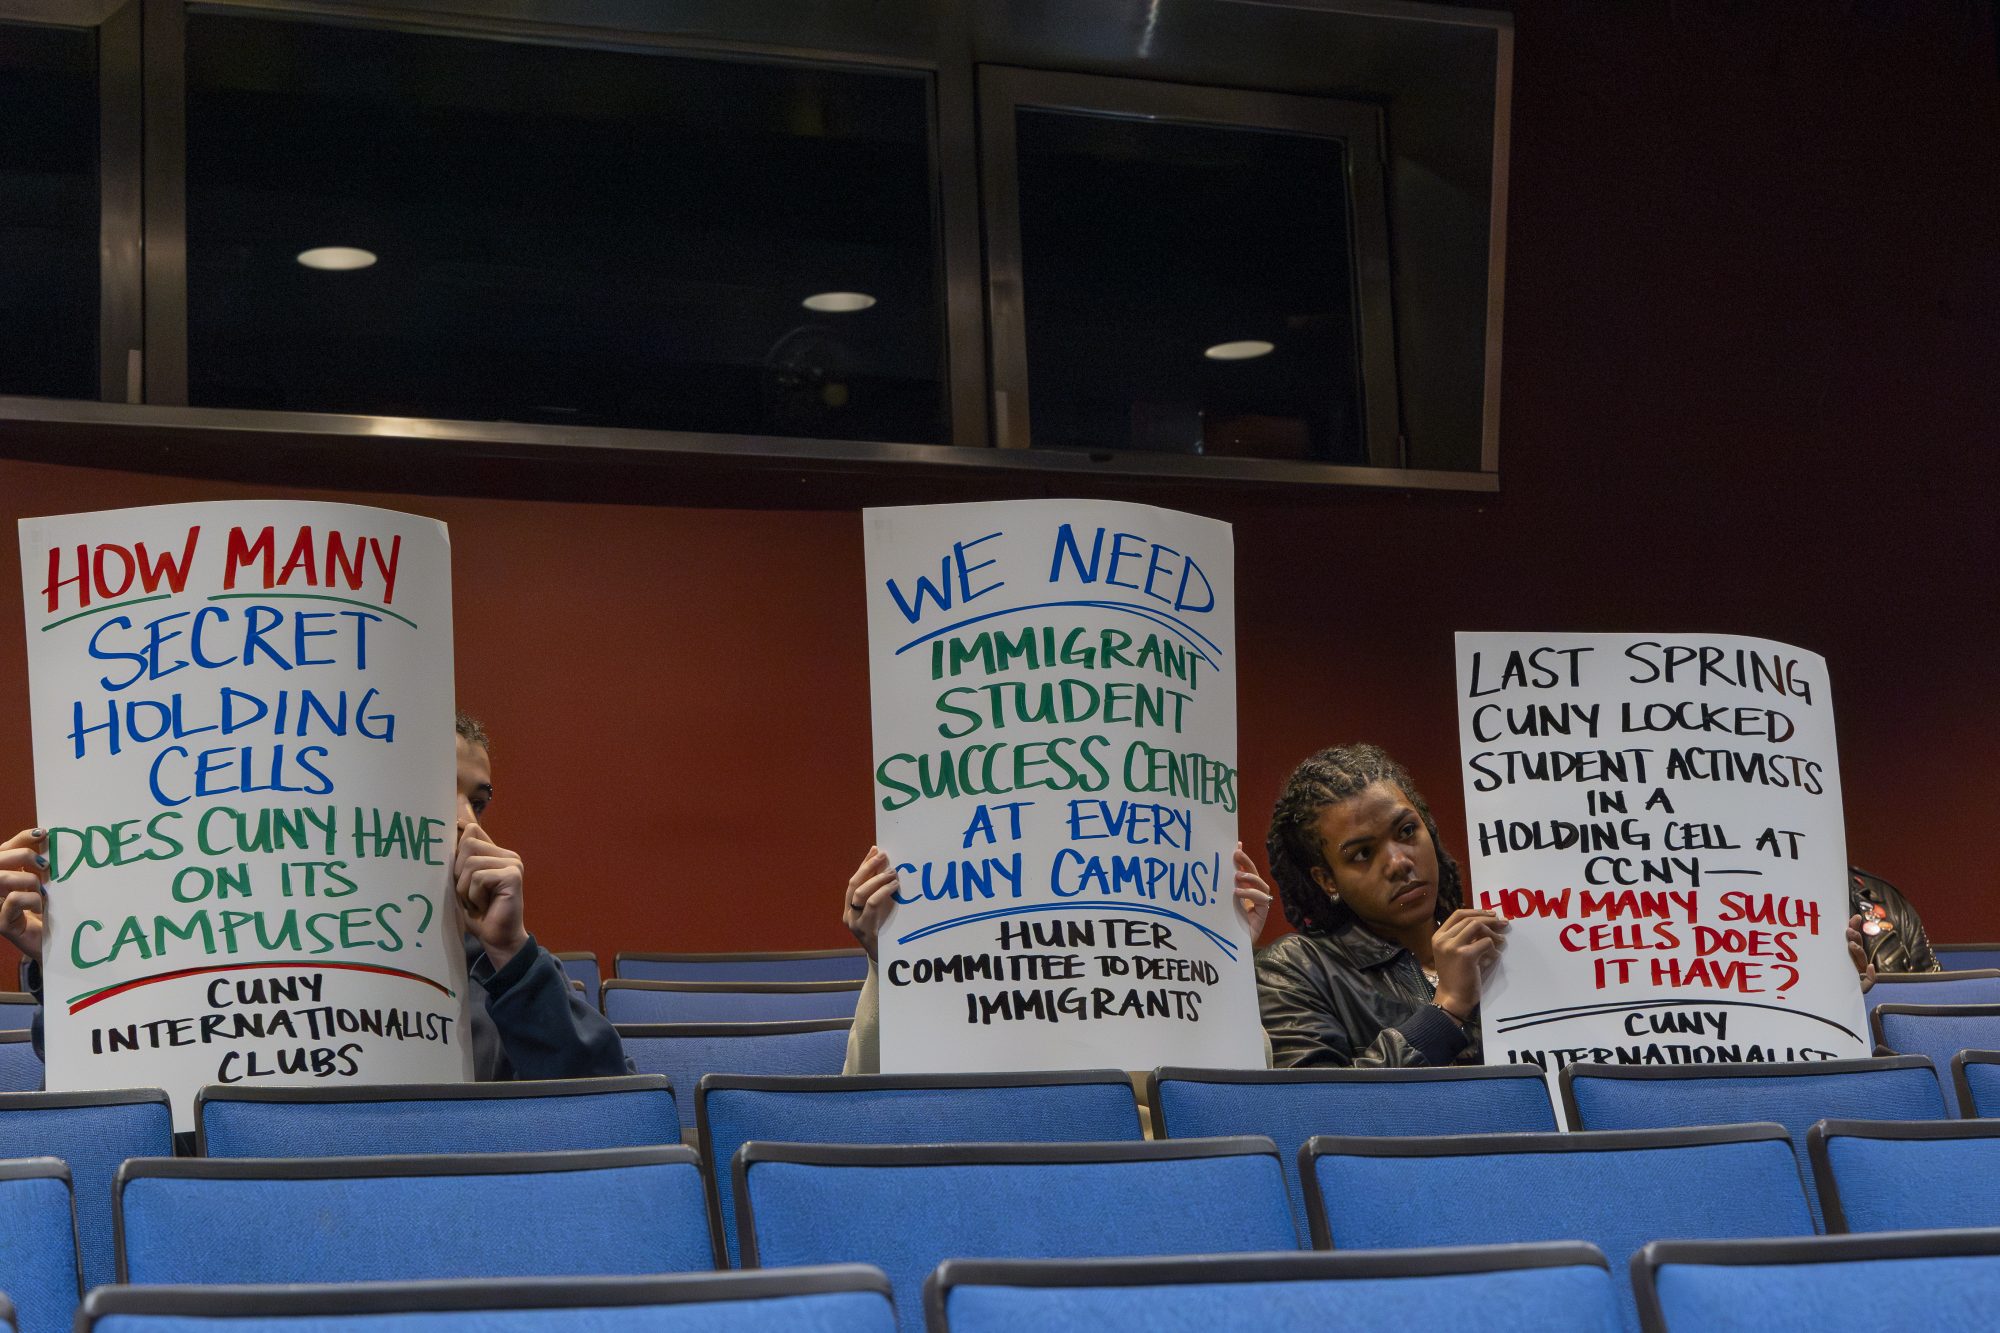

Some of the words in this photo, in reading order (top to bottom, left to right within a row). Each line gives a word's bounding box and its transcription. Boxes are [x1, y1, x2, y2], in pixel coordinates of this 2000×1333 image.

[42, 526, 200, 613] HOW
[224, 526, 401, 604] MANY
[886, 532, 1005, 624] WE
[1049, 524, 1215, 613] NEED
[88, 605, 382, 692] SECRET
[931, 626, 1204, 690] IMMIGRANT
[1469, 646, 1595, 698] LAST
[1624, 642, 1812, 706] SPRING
[67, 687, 395, 759] HOLDING
[936, 679, 1194, 738] STUDENT
[1472, 703, 1600, 743] CUNY
[1621, 701, 1795, 743] LOCKED
[149, 745, 334, 806] CELLS
[876, 735, 1110, 811] SUCCESS
[1123, 741, 1237, 813] CENTERS
[1469, 748, 1654, 792] STUDENT
[1666, 746, 1823, 795] ACTIVISTS
[962, 801, 1036, 848] AT
[1066, 799, 1192, 851] EVERY
[1586, 789, 1628, 817] IN
[1645, 787, 1675, 814] A
[46, 811, 184, 883] DOES
[197, 805, 337, 855] CUNY
[352, 806, 445, 865] HAVE
[1478, 818, 1651, 857] HOLDING
[1664, 821, 1741, 851] CELL
[1755, 827, 1807, 861] AT
[171, 862, 252, 903] ON
[281, 860, 358, 897] ITS
[891, 852, 1022, 905] CUNY
[1051, 848, 1220, 907] CAMPUS!
[70, 893, 434, 969] CAMPUSES?
[995, 919, 1177, 951] HUNTER
[1480, 888, 1571, 920] HOW
[1580, 889, 1698, 924] MANY
[1718, 890, 1821, 936] SUCH
[1559, 921, 1681, 952] CELLS
[1692, 925, 1799, 963] DOES
[207, 973, 323, 1008] CUNY
[888, 953, 1086, 986] COMMITTEE
[1094, 954, 1128, 977] TO
[1132, 956, 1219, 986] DEFEND
[1594, 957, 1639, 990] IT
[1650, 957, 1800, 1000] HAVE?
[966, 986, 1202, 1025] IMMIGRANTS
[1624, 1010, 1728, 1041] CUNY
[91, 1006, 454, 1054] INTERNATIONALIST
[217, 1043, 364, 1083] CLUBS
